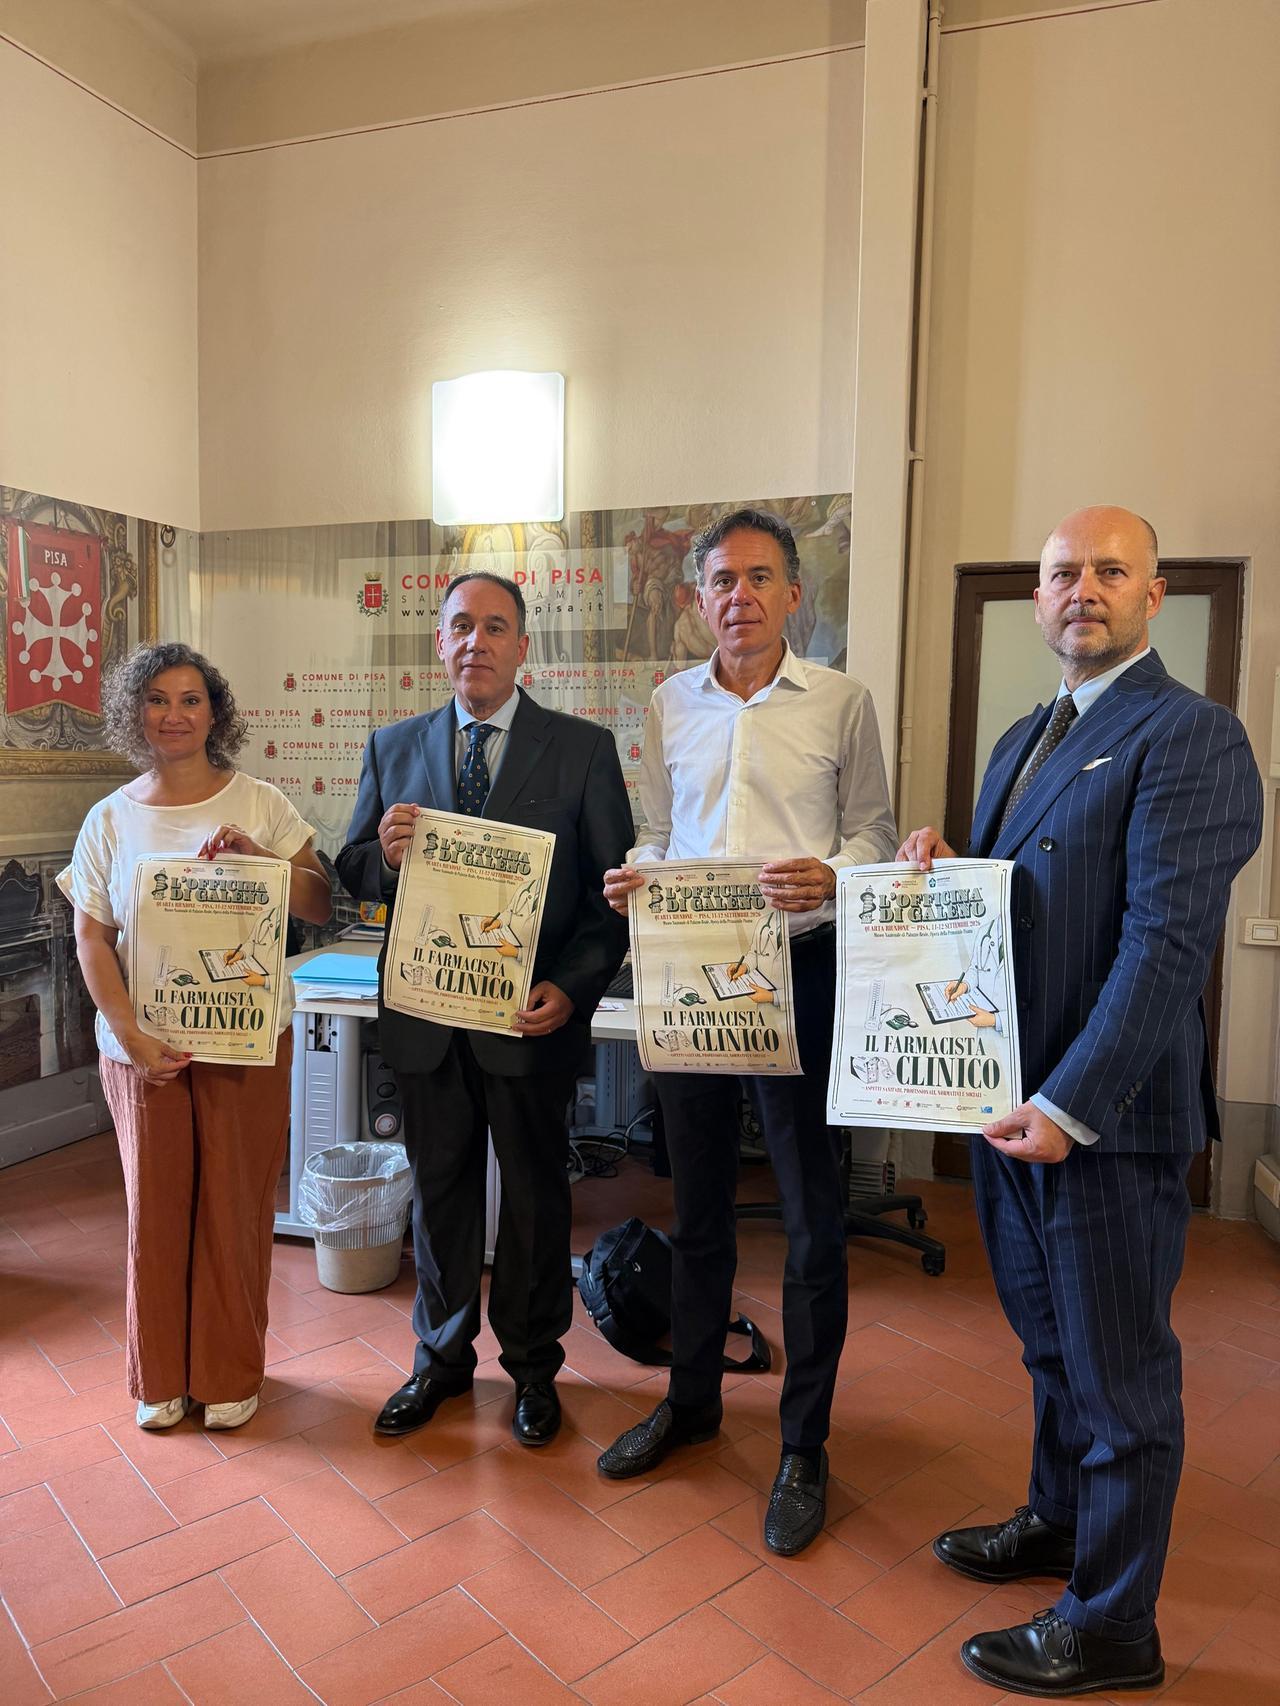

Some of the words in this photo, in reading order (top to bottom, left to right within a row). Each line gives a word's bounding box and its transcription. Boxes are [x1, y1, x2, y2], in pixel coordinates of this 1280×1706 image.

[44, 549, 67, 567] PISA
[402, 573, 450, 590] COM
[514, 571, 536, 585] DI
[552, 568, 603, 584] PISA
[402, 594, 442, 604] SAL
[521, 589, 603, 600] AMPA
[302, 673, 344, 681] COMUNE
[349, 673, 359, 681] DI
[364, 673, 386, 681] PISA
[541, 669, 588, 677] COMUNE
[594, 669, 605, 677] DI
[611, 669, 635, 677] PISA
[330, 709, 372, 717] COMUNE
[378, 709, 388, 717] DI
[393, 709, 415, 717] PISA
[572, 707, 619, 715] COMUNE
[626, 707, 637, 715] DI
[440, 837, 531, 864] L'OFFICINA
[438, 849, 459, 863] DI
[461, 853, 532, 876] GALENO
[170, 877, 268, 893] L'OFFICINA
[665, 884, 763, 900] L'OFFICINA
[170, 887, 194, 901] DI
[195, 889, 269, 905] GALENO
[666, 900, 688, 912] DI
[690, 897, 766, 912] GALENO
[879, 887, 984, 909] L'OFFICINA
[879, 907, 907, 924] DI
[908, 902, 986, 922] GALENO
[413, 947, 424, 962] IL
[428, 950, 505, 977] FARMACISTA
[435, 967, 514, 1000] CLINICO
[154, 989, 166, 1003] IL
[170, 990, 254, 1006] FARMACISTA
[180, 1006, 264, 1031] CLINICO
[663, 1011, 676, 1026] IL
[680, 1011, 765, 1026] FARMACISTA
[692, 1027, 779, 1052] CLINICO
[865, 1035, 879, 1052] IL
[884, 1035, 986, 1056] FARMACISTA
[896, 1055, 1001, 1089] CLINICO
